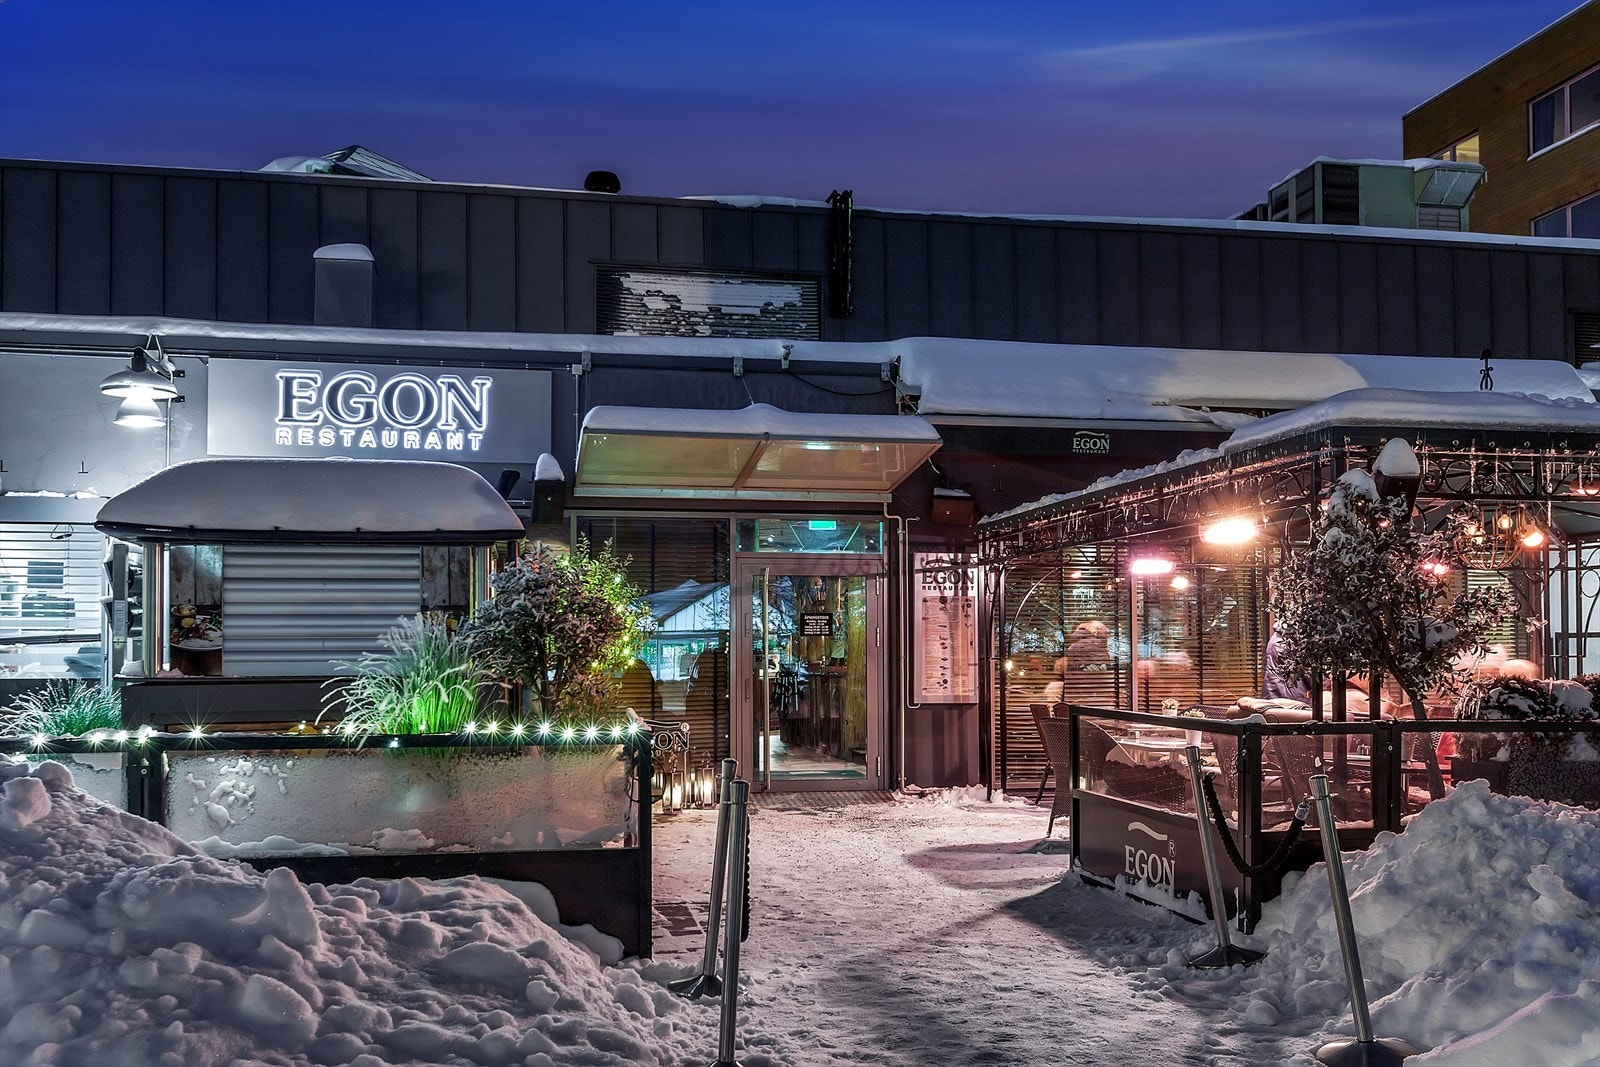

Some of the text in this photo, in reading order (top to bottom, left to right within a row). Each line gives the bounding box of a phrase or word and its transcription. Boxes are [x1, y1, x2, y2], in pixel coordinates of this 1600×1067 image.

[275, 370, 492, 430] EGON
[275, 427, 484, 450] RESTAURANT
[1072, 437, 1110, 450] EGON
[921, 569, 975, 585] EGON
[1124, 844, 1176, 896] EGON
